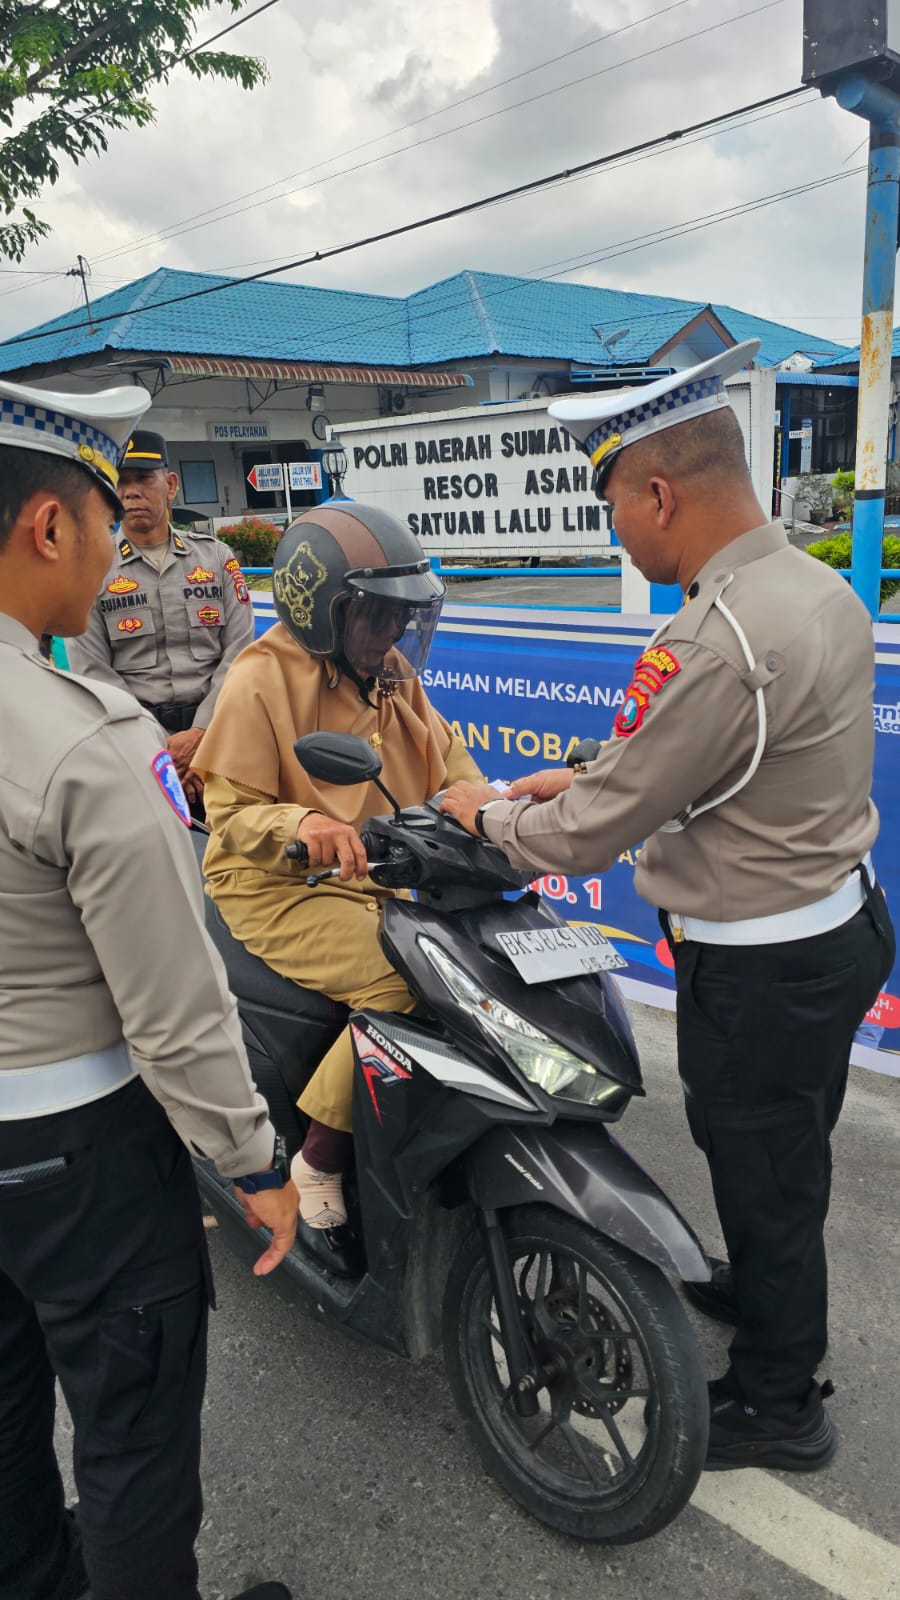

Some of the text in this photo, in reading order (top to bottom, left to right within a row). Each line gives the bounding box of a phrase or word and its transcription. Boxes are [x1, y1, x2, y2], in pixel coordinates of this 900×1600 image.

[214, 425, 268, 437] POS PELAYANAN
[353, 426, 583, 469] POLRI DAERAH SUMAT
[423, 473, 498, 500] RESOR
[408, 510, 485, 536] SATUAN
[494, 507, 551, 534] LALU
[100, 593, 148, 612] SUJARMAN
[183, 585, 223, 600] POLRI
[582, 878, 602, 911] 1
[500, 924, 608, 956] BK 5849 VBB
[366, 1024, 413, 1072] HONDA
